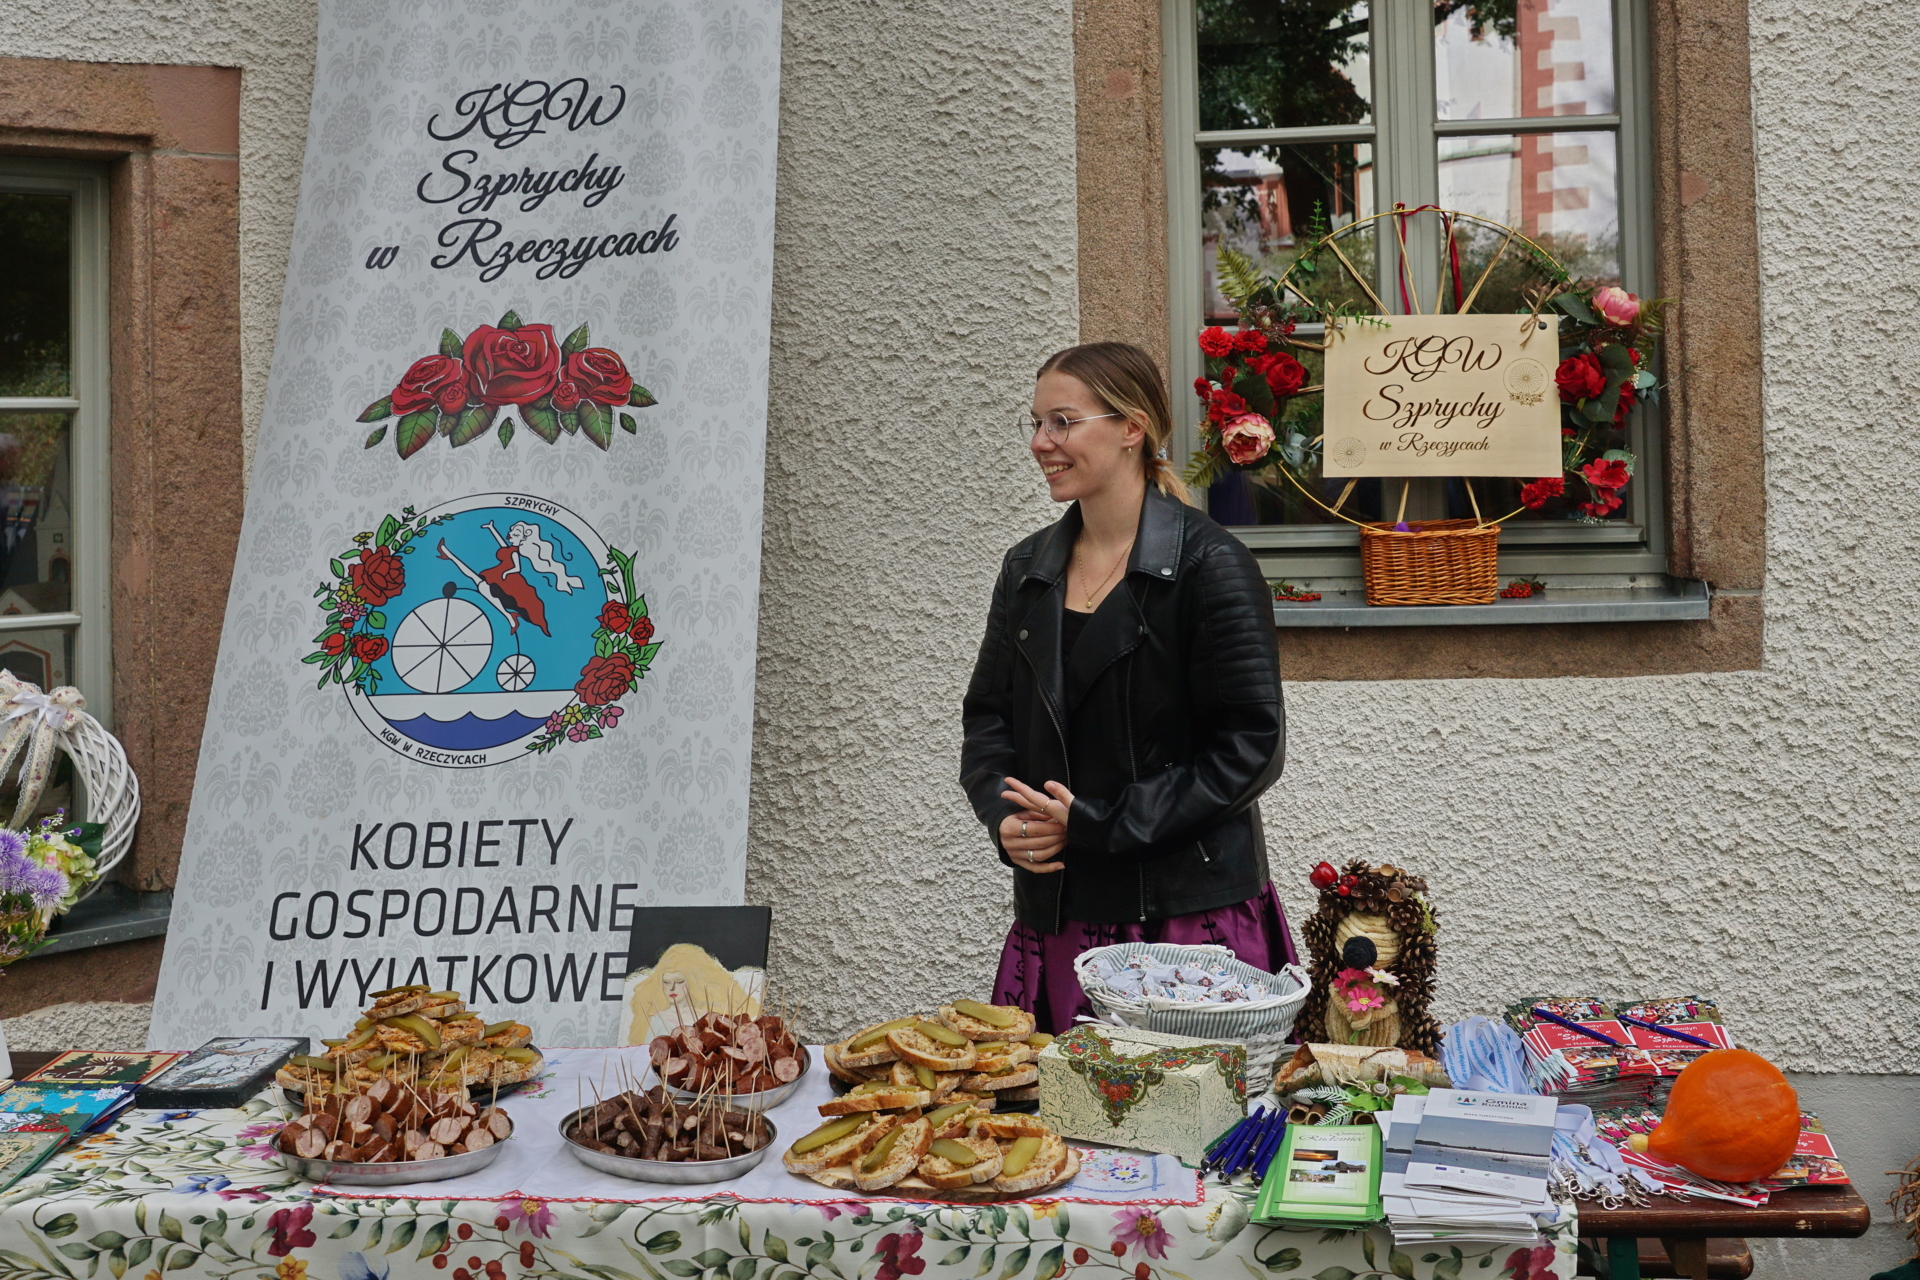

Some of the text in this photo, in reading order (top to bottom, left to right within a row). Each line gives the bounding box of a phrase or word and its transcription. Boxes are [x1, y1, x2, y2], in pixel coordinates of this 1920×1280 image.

[427, 77, 626, 149] KGW
[416, 150, 625, 214] Szprychy
[365, 213, 680, 283] w Rzeczycach
[1364, 335, 1502, 382] KGW
[1362, 384, 1505, 429] Szprychy
[1379, 432, 1490, 457] w Rzeczycach
[504, 496, 560, 517] SZPRYCHY
[380, 727, 487, 765] KGW W RZECZYCACH
[350, 818, 574, 870] KOBIETY
[268, 883, 638, 941] GOSPODARNE
[261, 961, 274, 1010] I
[1481, 1102, 1530, 1110] Rudziniec
[1485, 1098, 1527, 1106] Gmina
